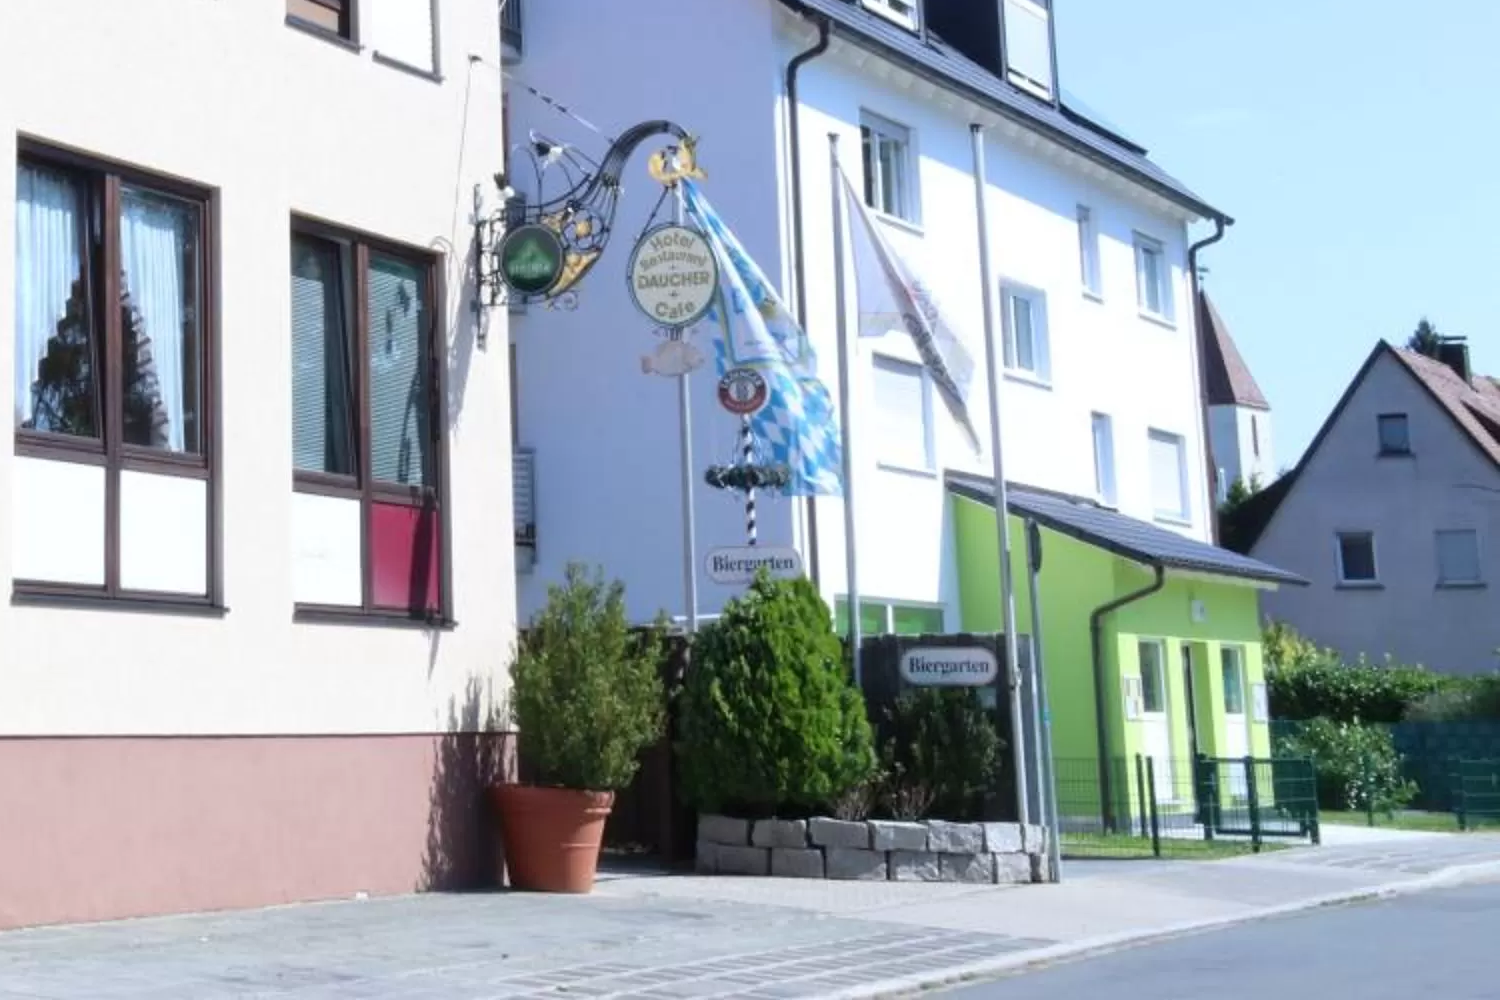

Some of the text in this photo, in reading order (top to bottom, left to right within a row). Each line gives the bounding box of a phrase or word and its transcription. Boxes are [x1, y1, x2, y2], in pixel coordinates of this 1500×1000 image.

[649, 231, 696, 250] Hotel
[637, 271, 710, 290] DAUCHER
[712, 554, 794, 573] Biergarten
[908, 655, 990, 675] Biergarten
